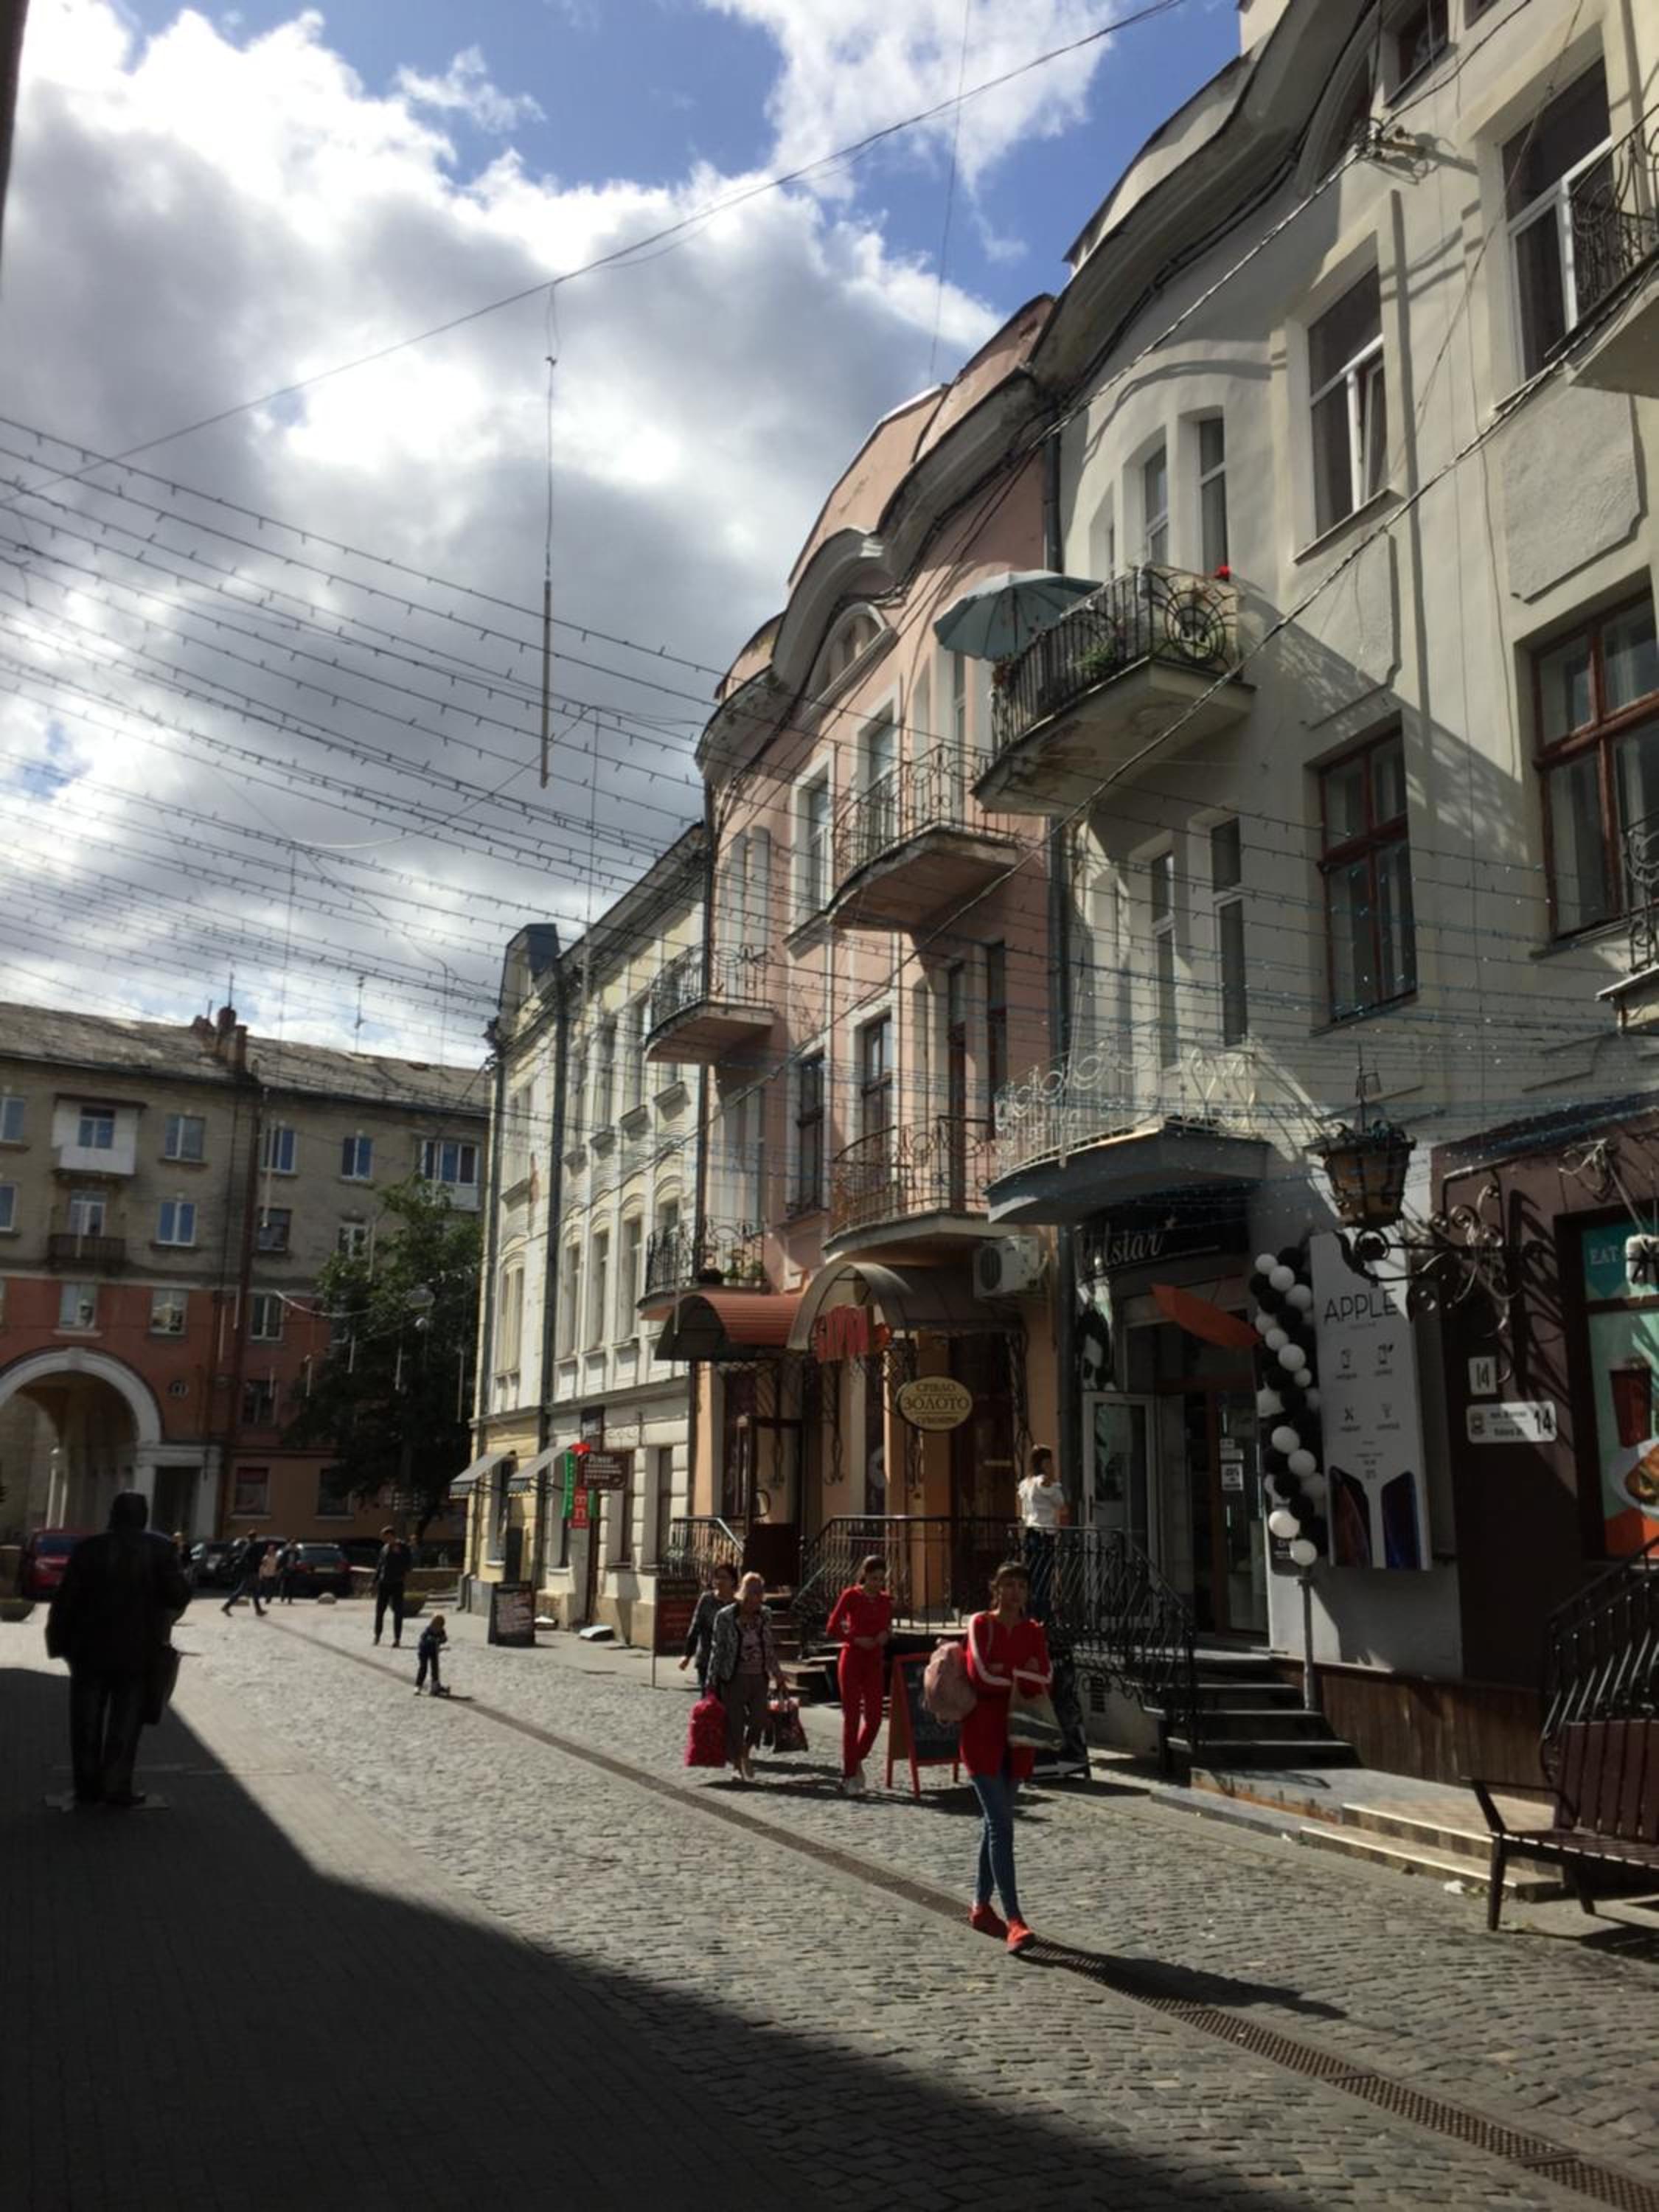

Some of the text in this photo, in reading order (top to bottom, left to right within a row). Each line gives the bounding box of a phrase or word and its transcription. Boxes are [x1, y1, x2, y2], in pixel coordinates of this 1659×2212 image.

[1324, 1288, 1398, 1325] APPLE
[1476, 1363, 1489, 1389] 14
[903, 1397, 969, 1411] ЗОЛОТО
[1534, 1408, 1552, 1435] 14
